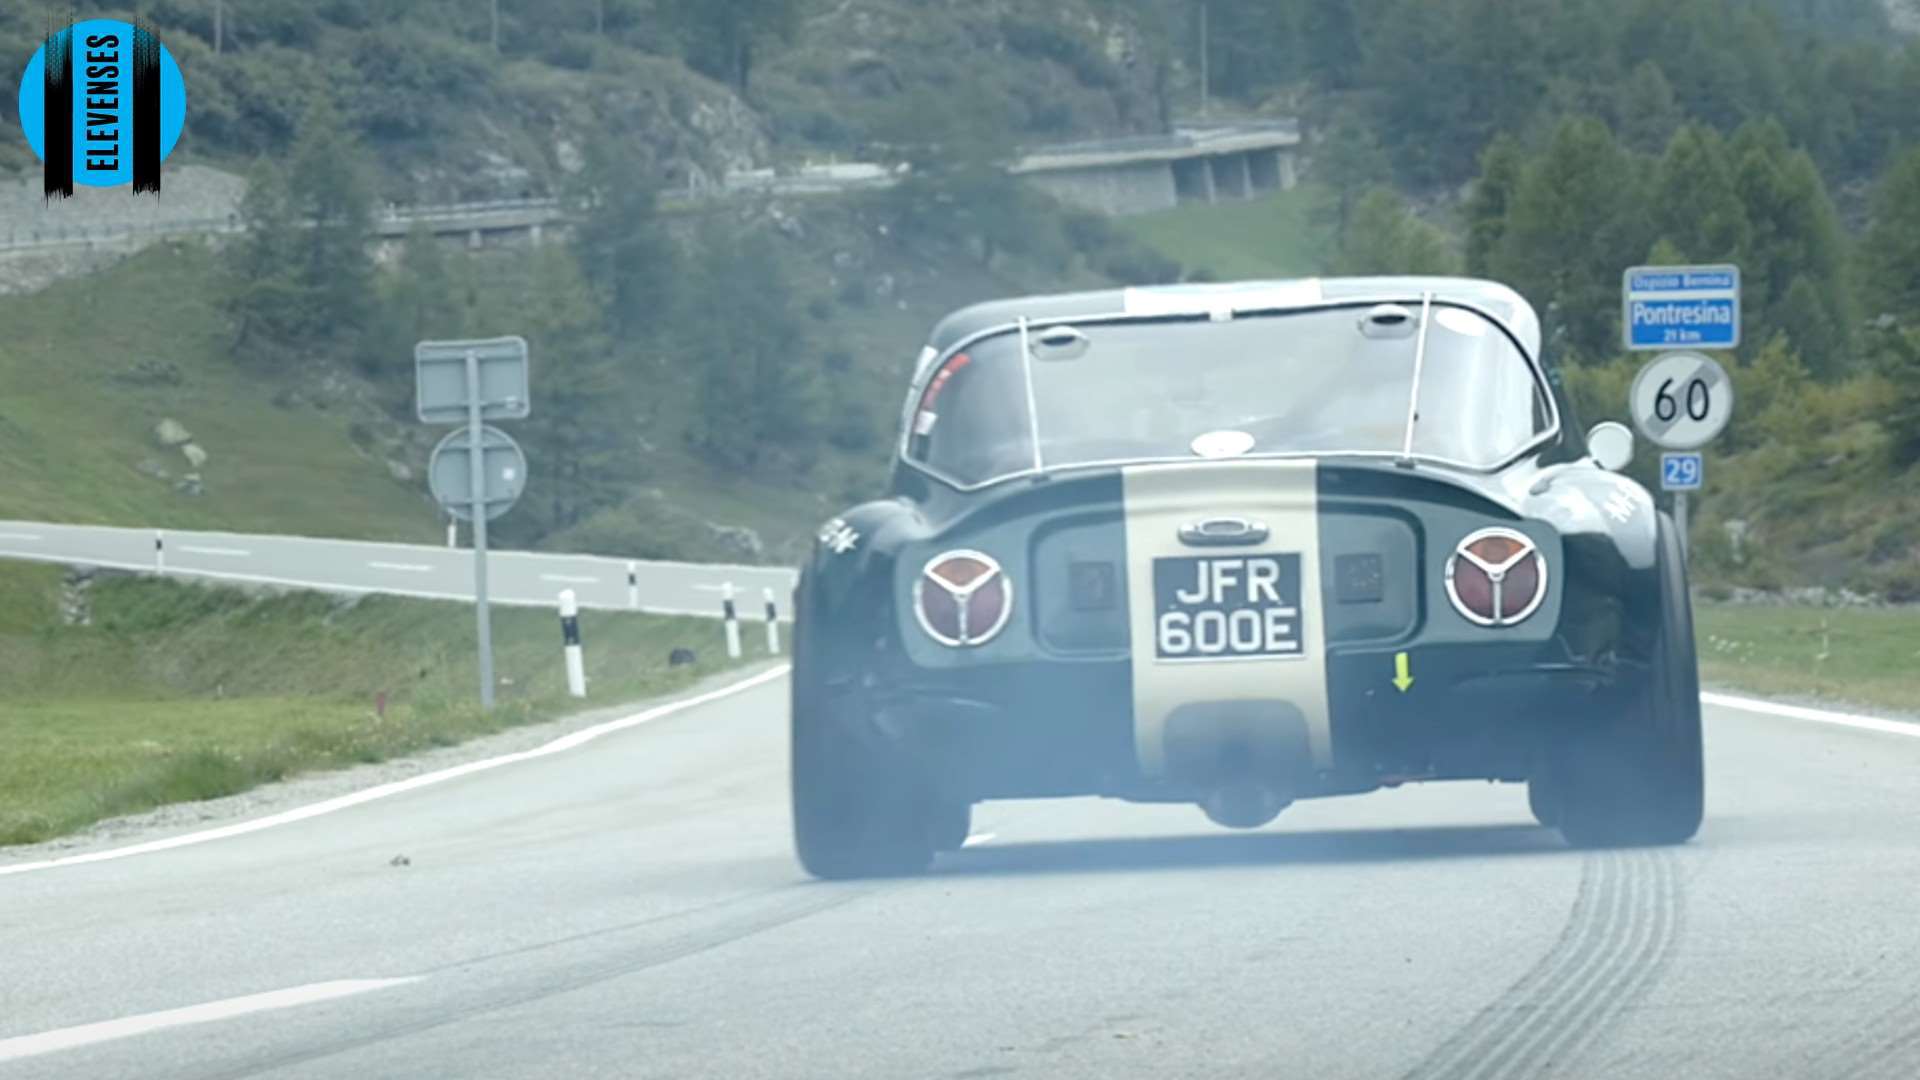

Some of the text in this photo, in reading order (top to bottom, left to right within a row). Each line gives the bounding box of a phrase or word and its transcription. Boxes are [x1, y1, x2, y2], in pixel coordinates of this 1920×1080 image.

[1633, 301, 1730, 324] Pontresina
[1680, 328, 1701, 340] km
[1654, 378, 1709, 422] 60
[1666, 458, 1697, 484] 29
[1176, 558, 1281, 604] JFR
[1159, 607, 1298, 653] 600E
